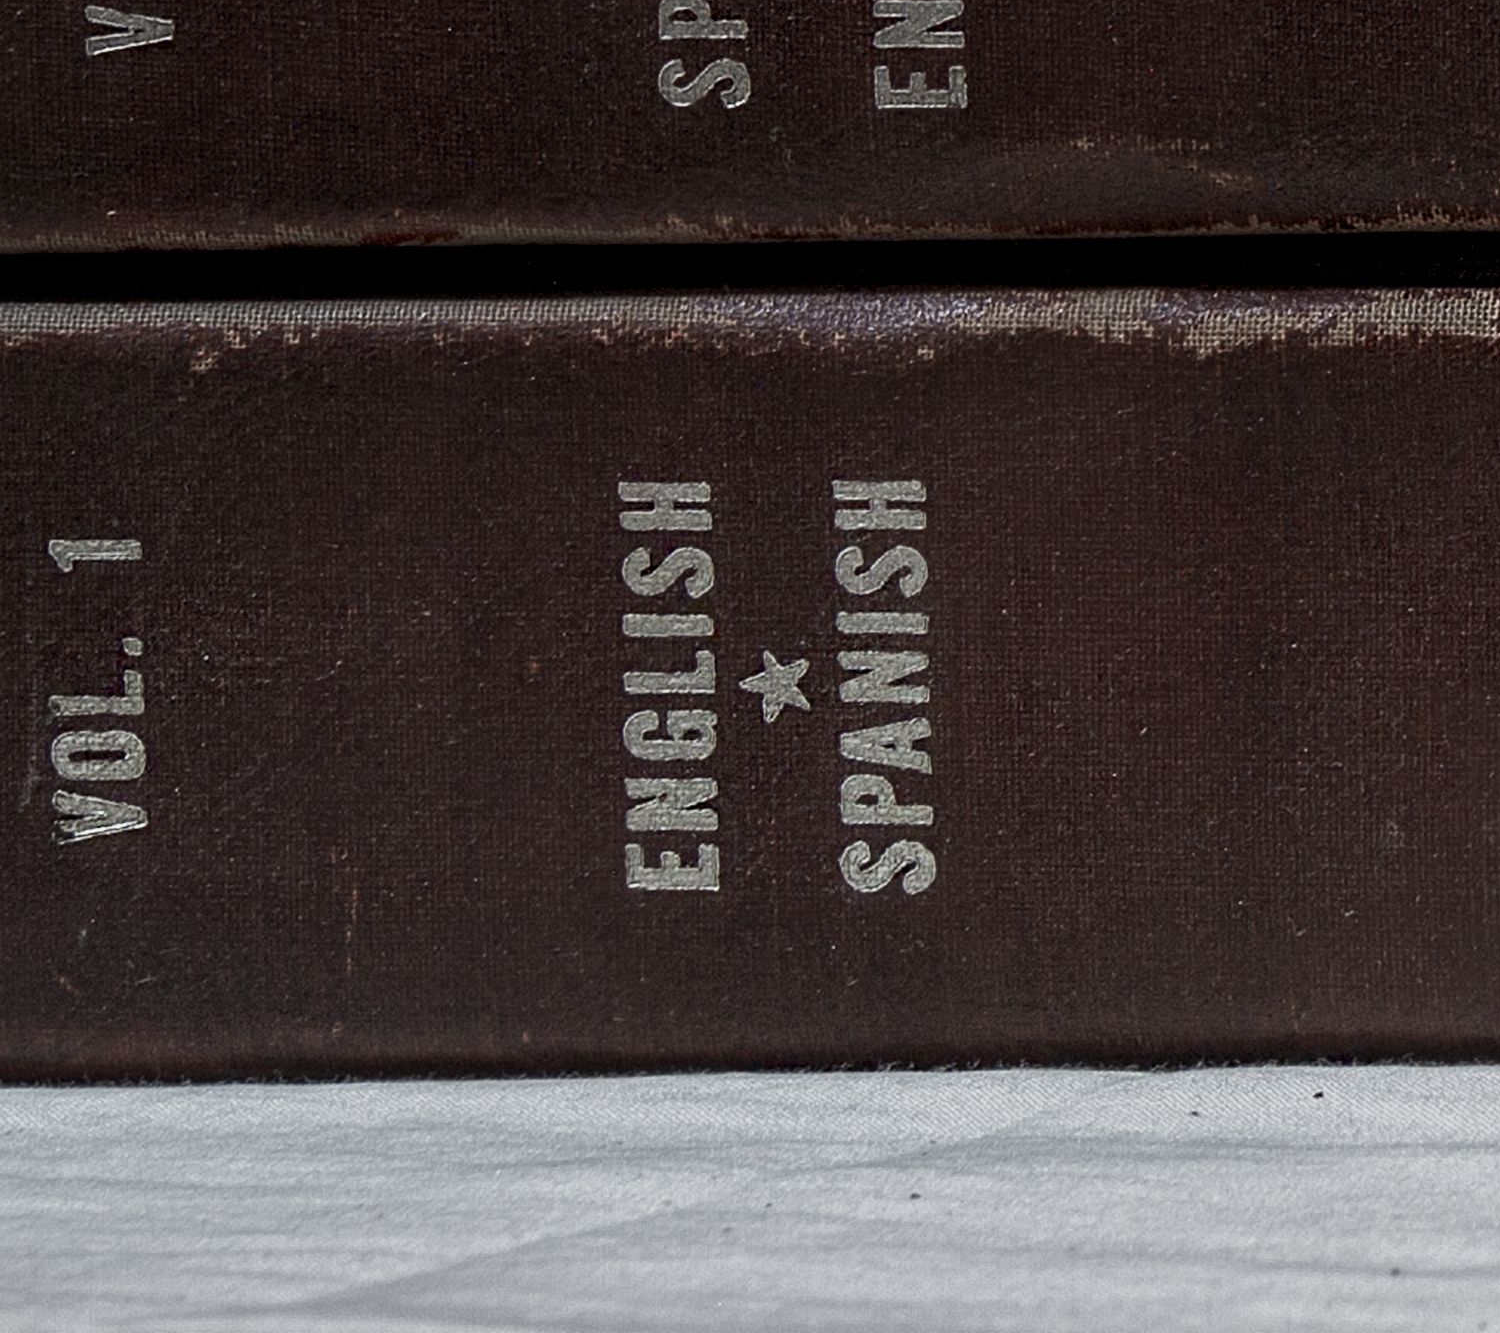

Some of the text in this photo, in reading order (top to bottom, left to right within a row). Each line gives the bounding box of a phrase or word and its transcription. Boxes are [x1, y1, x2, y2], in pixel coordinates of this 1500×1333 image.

[50, 535, 147, 840] VOL. 1
[621, 477, 719, 890] ENGLISH
[833, 477, 935, 893] SPANISH
